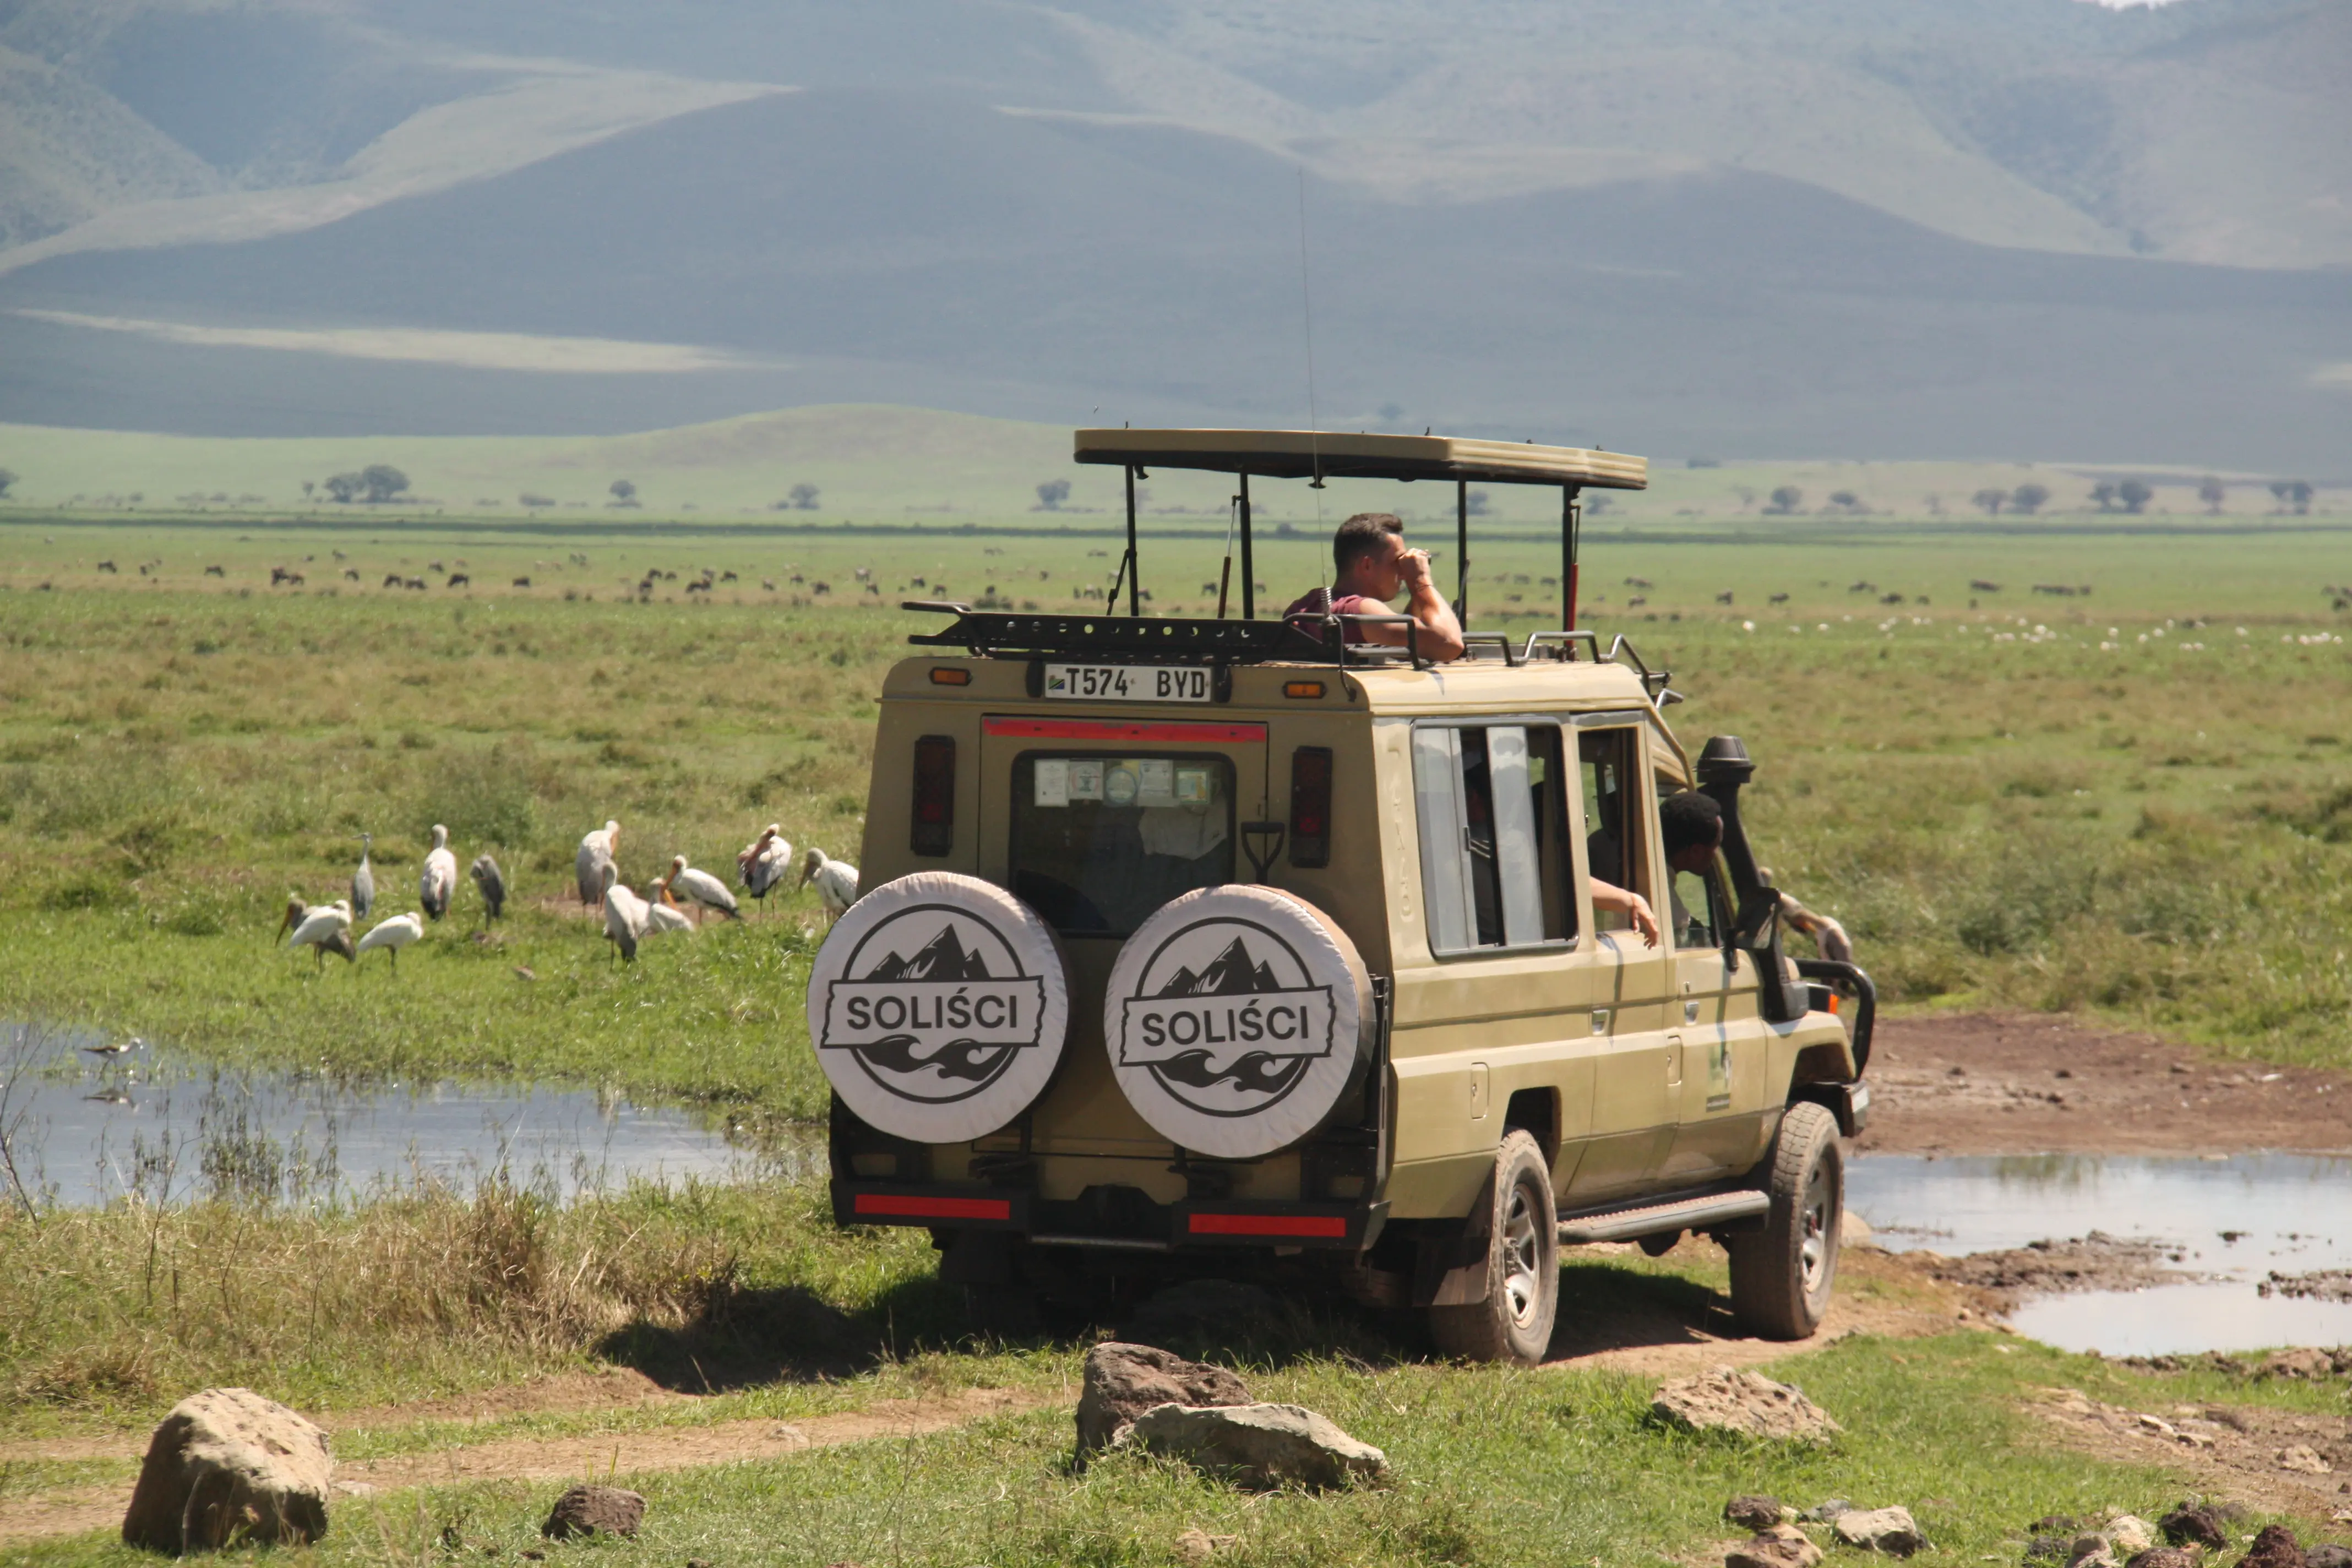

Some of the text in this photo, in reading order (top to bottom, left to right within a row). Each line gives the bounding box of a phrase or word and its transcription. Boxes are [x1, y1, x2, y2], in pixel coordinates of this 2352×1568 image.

[1065, 667, 1205, 698] T574 BYD
[847, 987, 1017, 1030] SOLIŚCI
[1142, 998, 1309, 1047] SOLIŚCI
